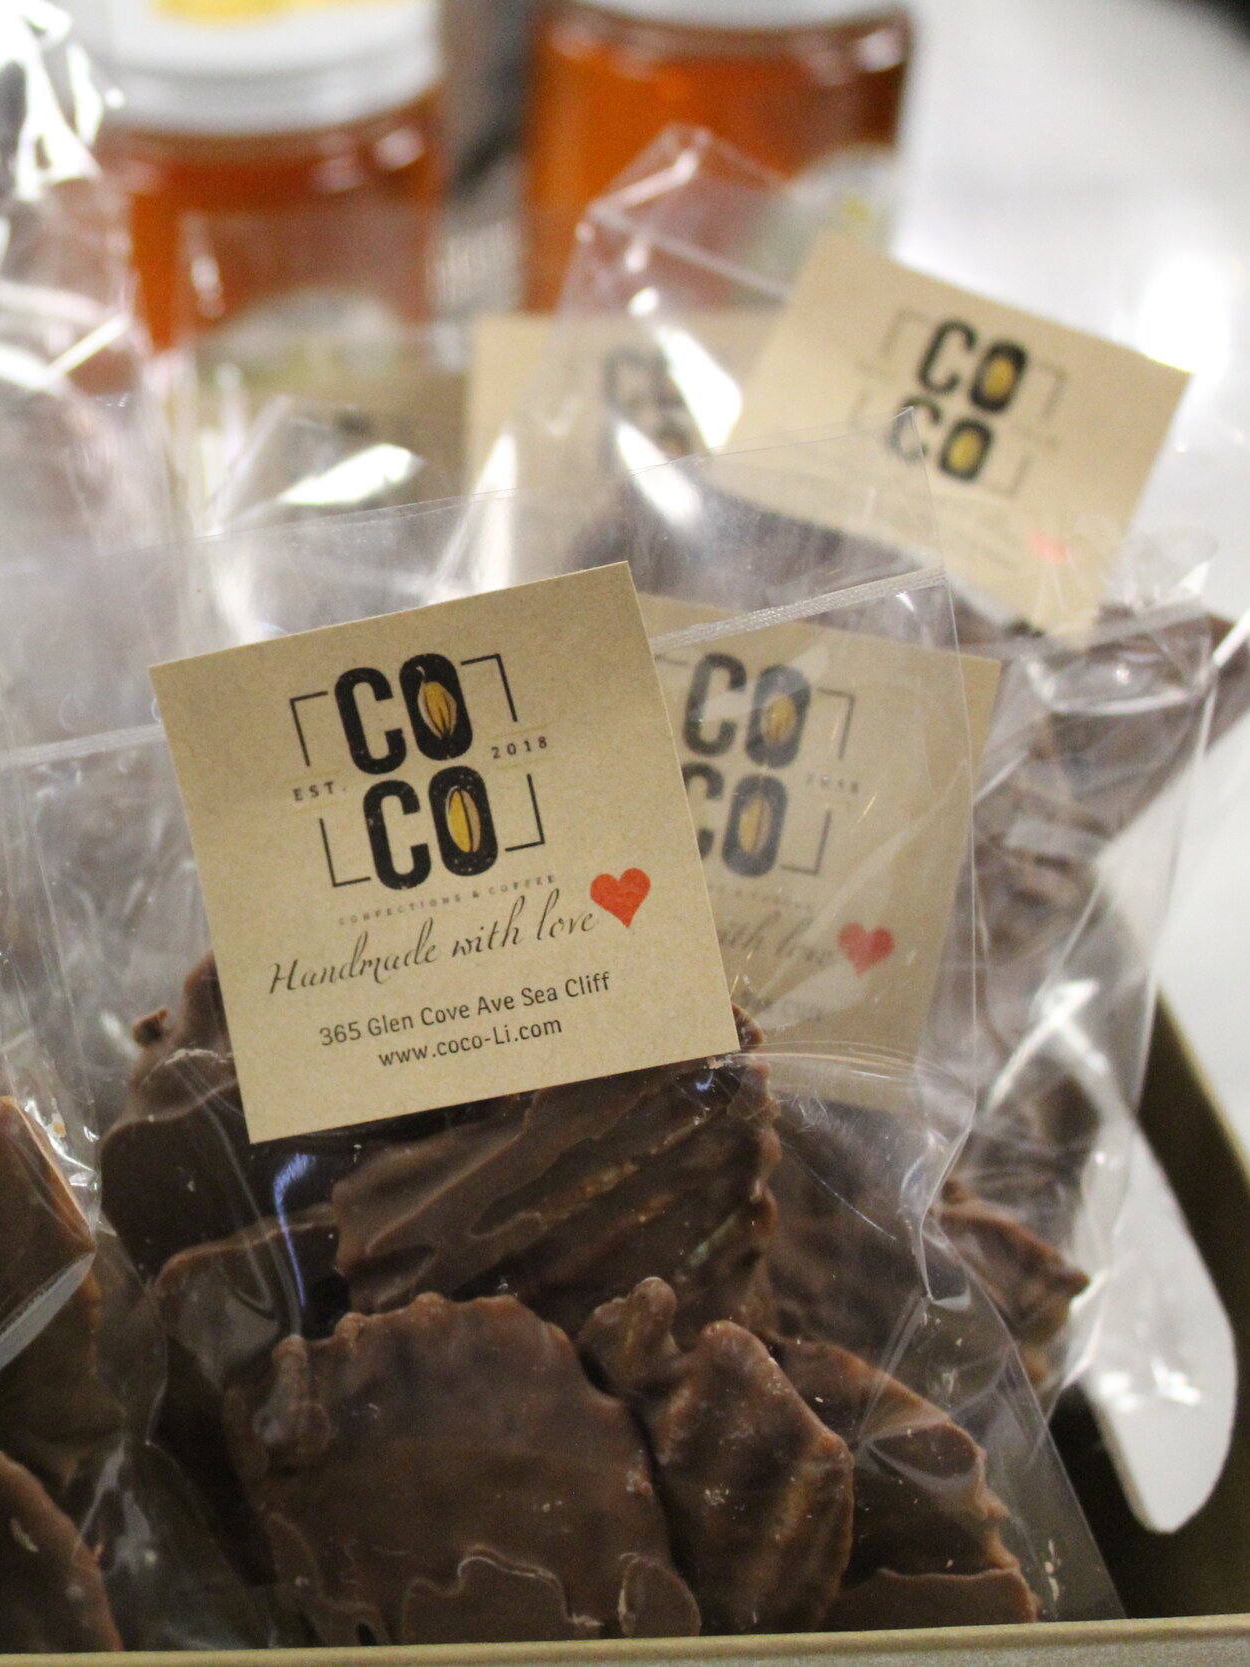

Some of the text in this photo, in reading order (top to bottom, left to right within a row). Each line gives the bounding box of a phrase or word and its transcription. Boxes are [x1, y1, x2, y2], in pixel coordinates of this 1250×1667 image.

[917, 319, 1029, 416] CO
[334, 653, 473, 775] CO
[490, 735, 549, 760] 2018
[681, 652, 811, 769] CO
[293, 780, 349, 802] EST.
[362, 765, 499, 890] CO
[268, 887, 596, 995] Handmade with love
[318, 970, 612, 1047] 365 Glen Cove Ave Sea Cliff
[378, 1015, 563, 1068] www.coco-Li.com
